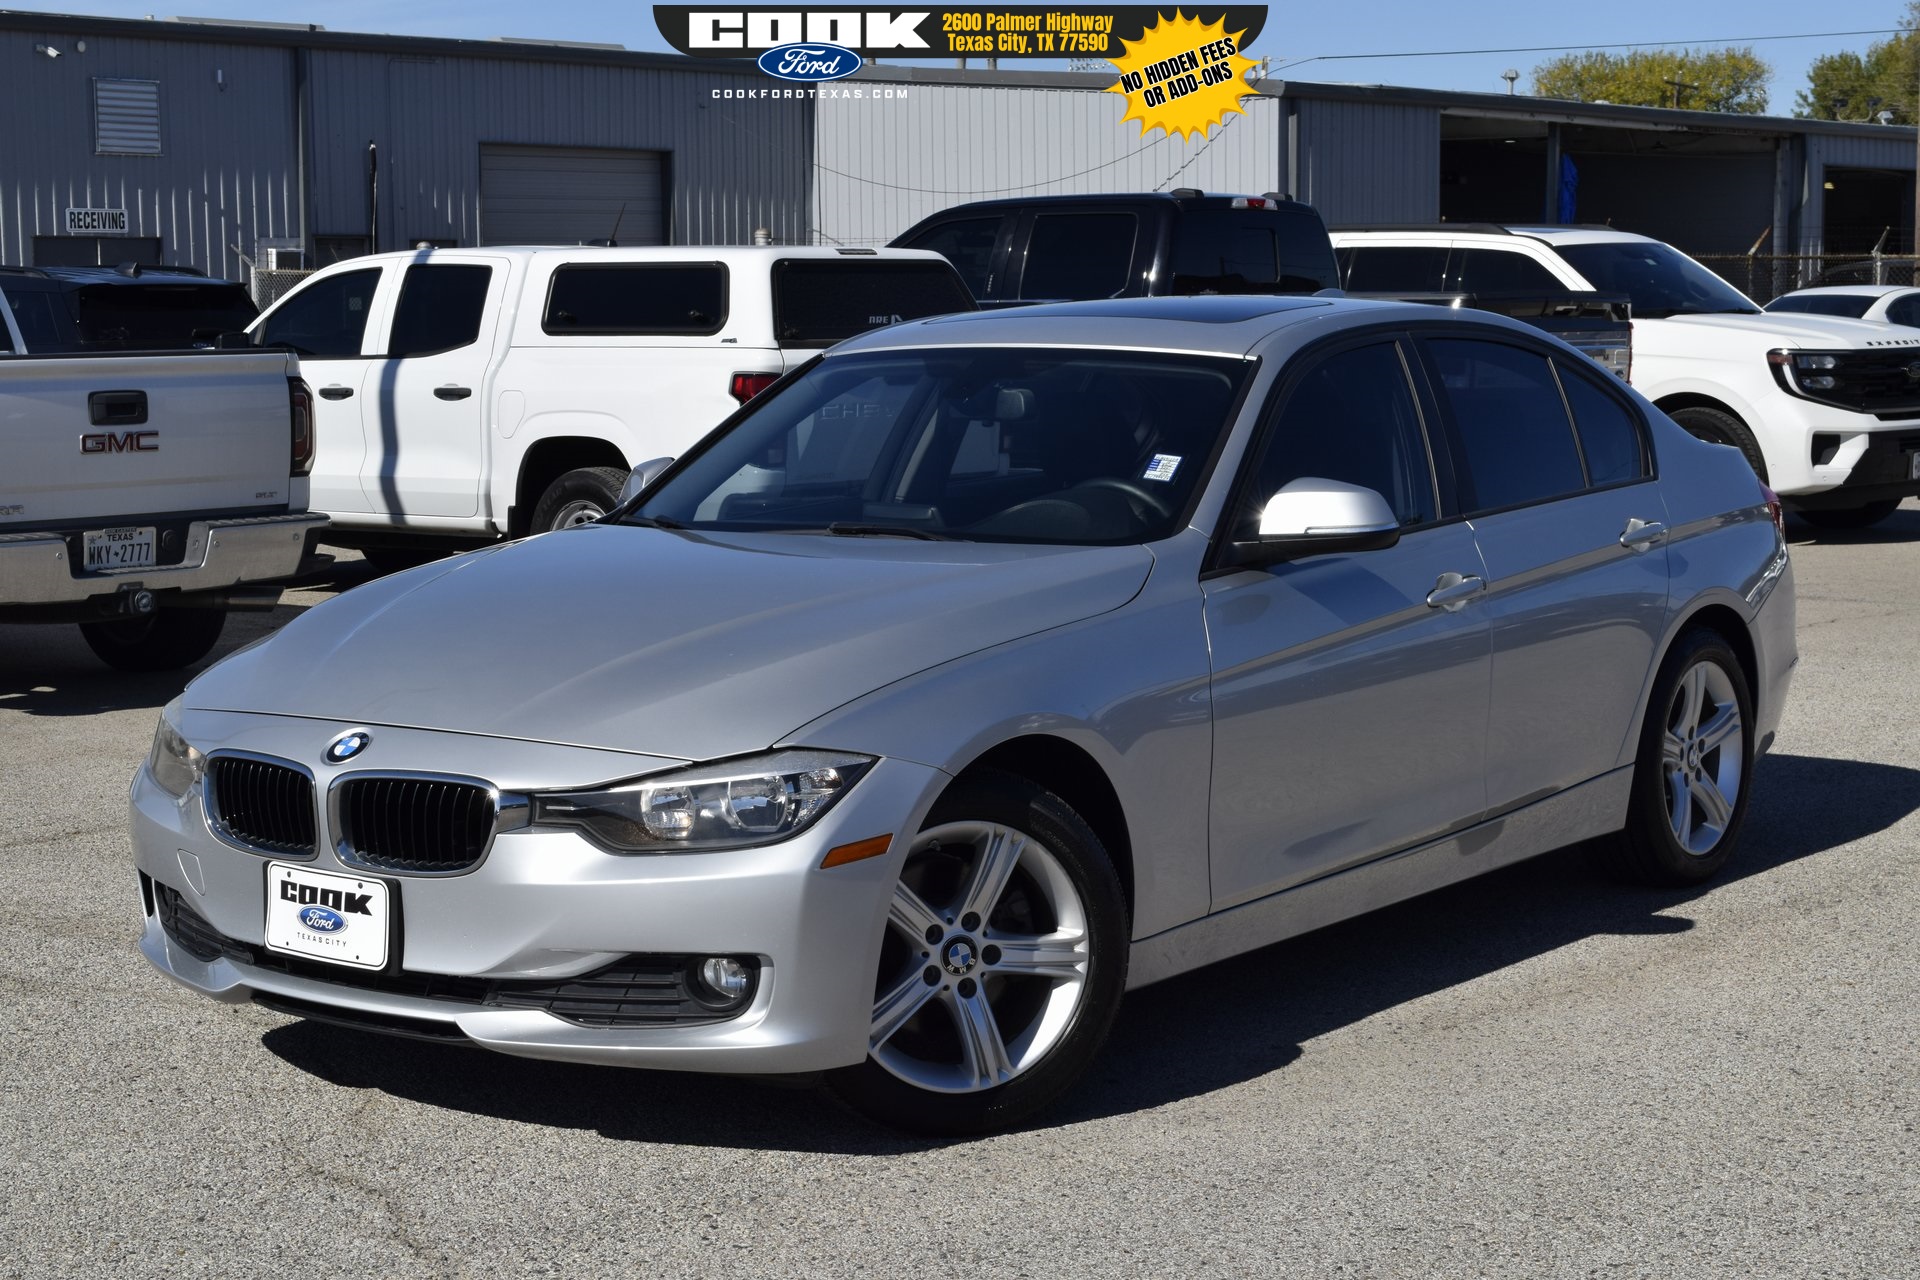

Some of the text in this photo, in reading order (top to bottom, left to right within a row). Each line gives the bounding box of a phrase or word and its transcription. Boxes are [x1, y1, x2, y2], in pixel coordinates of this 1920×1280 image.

[69, 211, 126, 230] RECEIVING
[80, 430, 160, 454] GMC
[107, 533, 133, 542] TEXAS
[280, 880, 373, 916] COOK
[306, 909, 335, 930] Ford
